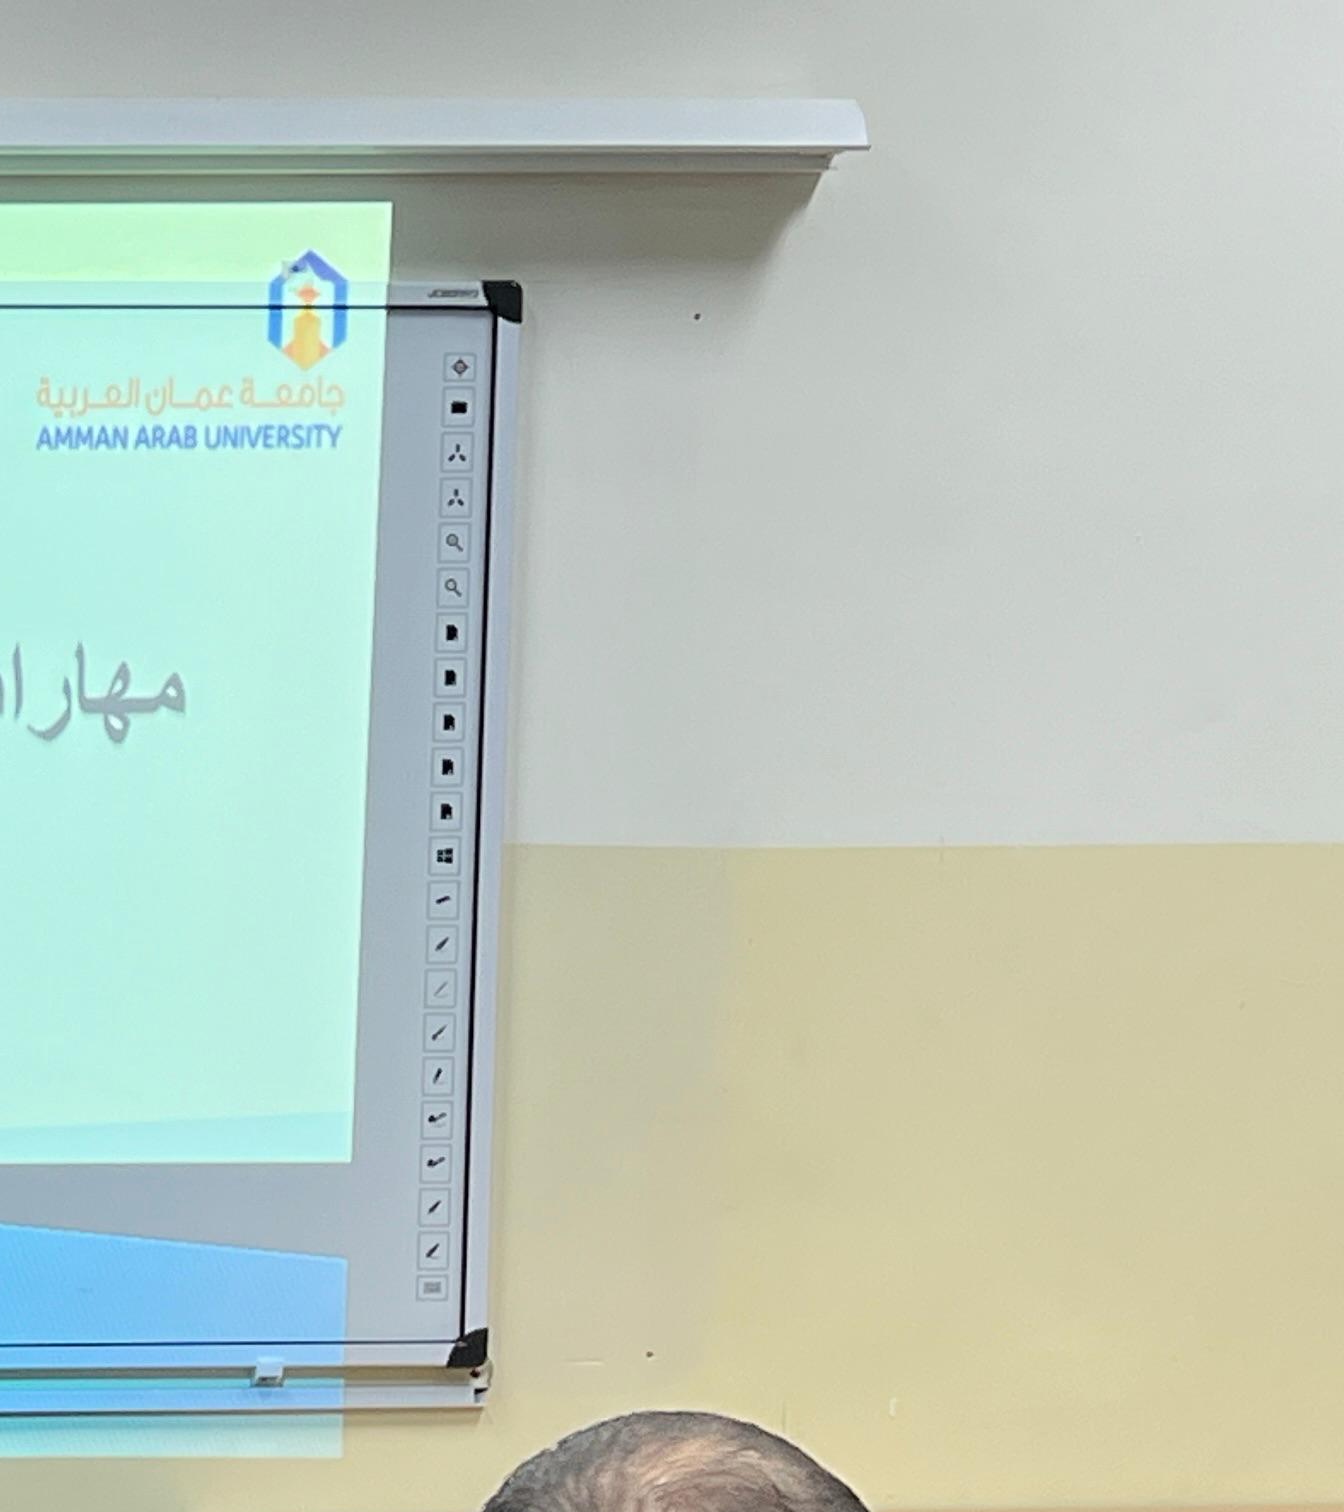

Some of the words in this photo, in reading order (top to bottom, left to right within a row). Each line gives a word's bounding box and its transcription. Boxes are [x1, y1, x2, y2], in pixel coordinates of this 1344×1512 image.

[35, 375, 140, 418] العربية
[144, 375, 233, 416] عمان
[238, 375, 345, 416] جامعة
[35, 424, 129, 450] AMMAN
[133, 424, 198, 450] ARAB
[203, 423, 343, 450] UNIVERSITY
